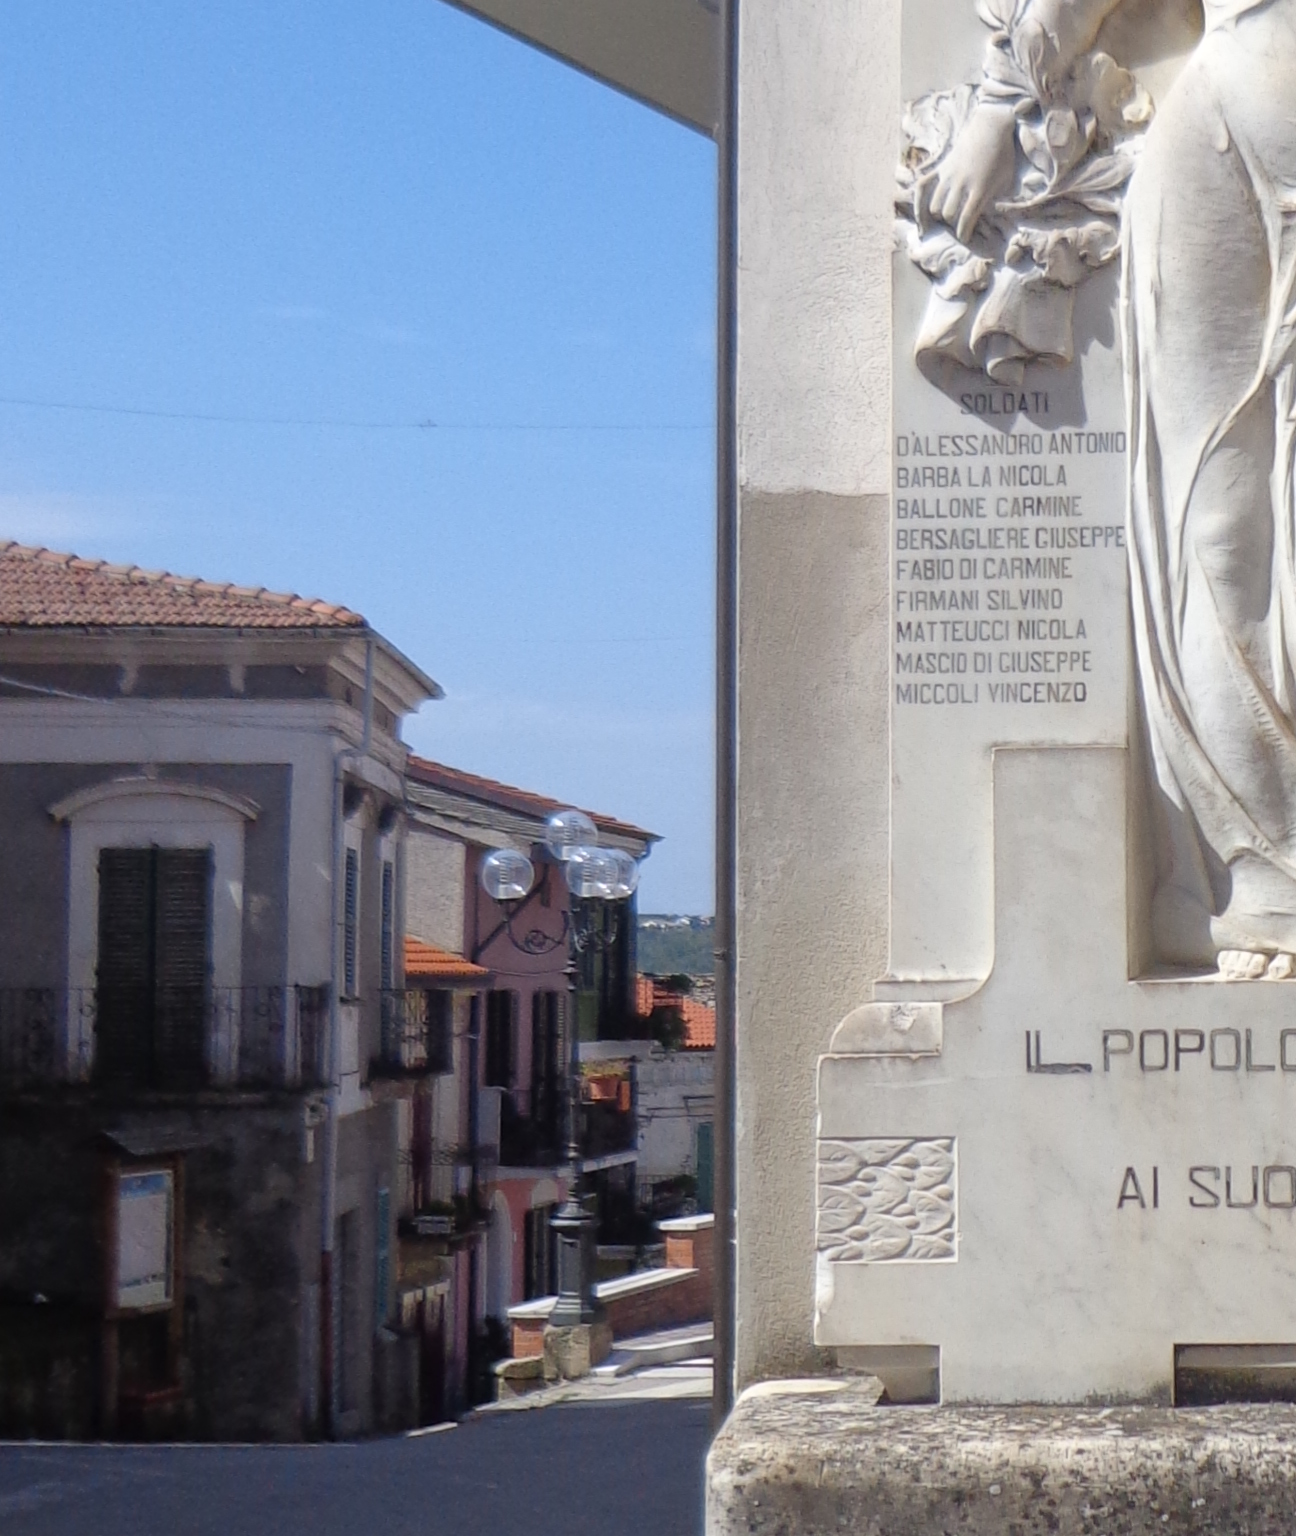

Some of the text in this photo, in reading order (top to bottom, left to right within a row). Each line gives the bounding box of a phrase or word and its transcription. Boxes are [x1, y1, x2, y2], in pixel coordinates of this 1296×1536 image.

[960, 393, 1049, 415] SOLDATI
[1049, 432, 1125, 454] ANTONIO
[897, 465, 1066, 488] BARBA LA NICOLA
[897, 497, 1082, 519] BALLONE CARMINE
[897, 526, 1125, 550] BERSAGLIERE GIUSEPPE
[896, 558, 1072, 580] FABIO DI CARMINE
[896, 589, 1062, 612] FIRMANI SILVINO
[896, 620, 1087, 643] MATTEUCCI NICOLA
[896, 651, 1091, 674] MASCIO DI GIUSEPPE
[896, 682, 1087, 705] MICCOLI VINCENZO
[1025, 1030, 1093, 1075] IL
[1117, 1166, 1159, 1209] AI
